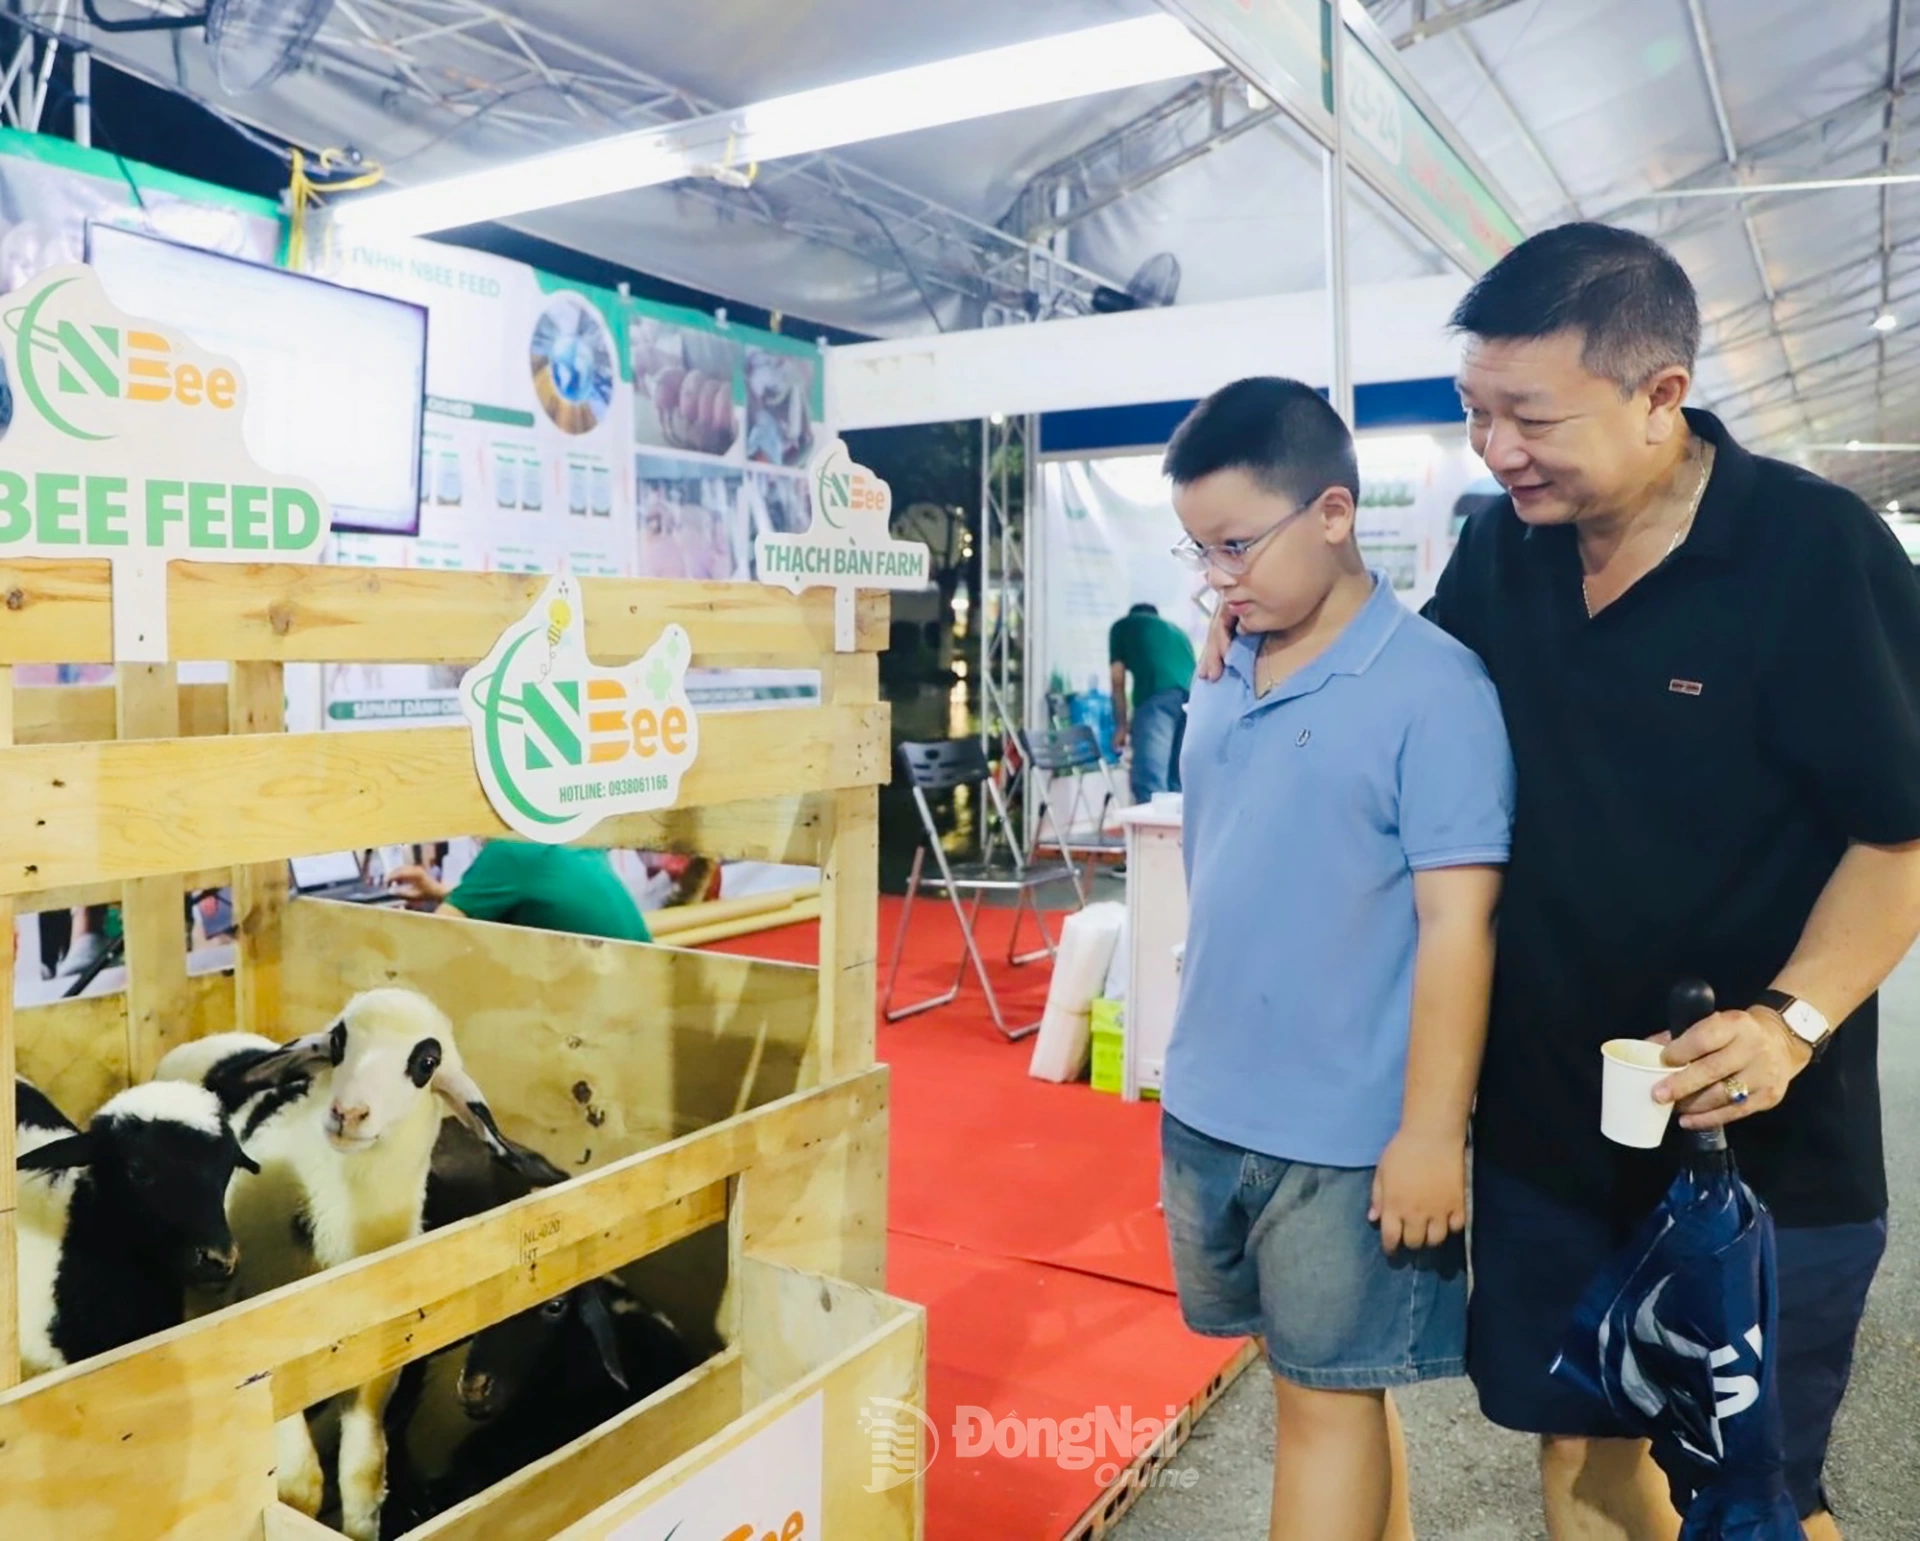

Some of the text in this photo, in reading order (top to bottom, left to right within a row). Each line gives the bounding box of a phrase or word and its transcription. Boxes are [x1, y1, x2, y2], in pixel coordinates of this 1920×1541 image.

[409, 259, 454, 288] NBEE
[457, 270, 502, 299] FEED
[145, 478, 321, 551] FEED
[764, 543, 831, 583] THẠCH
[876, 550, 924, 577] FARM
[558, 774, 669, 803] HOTLINE: 0938061166
